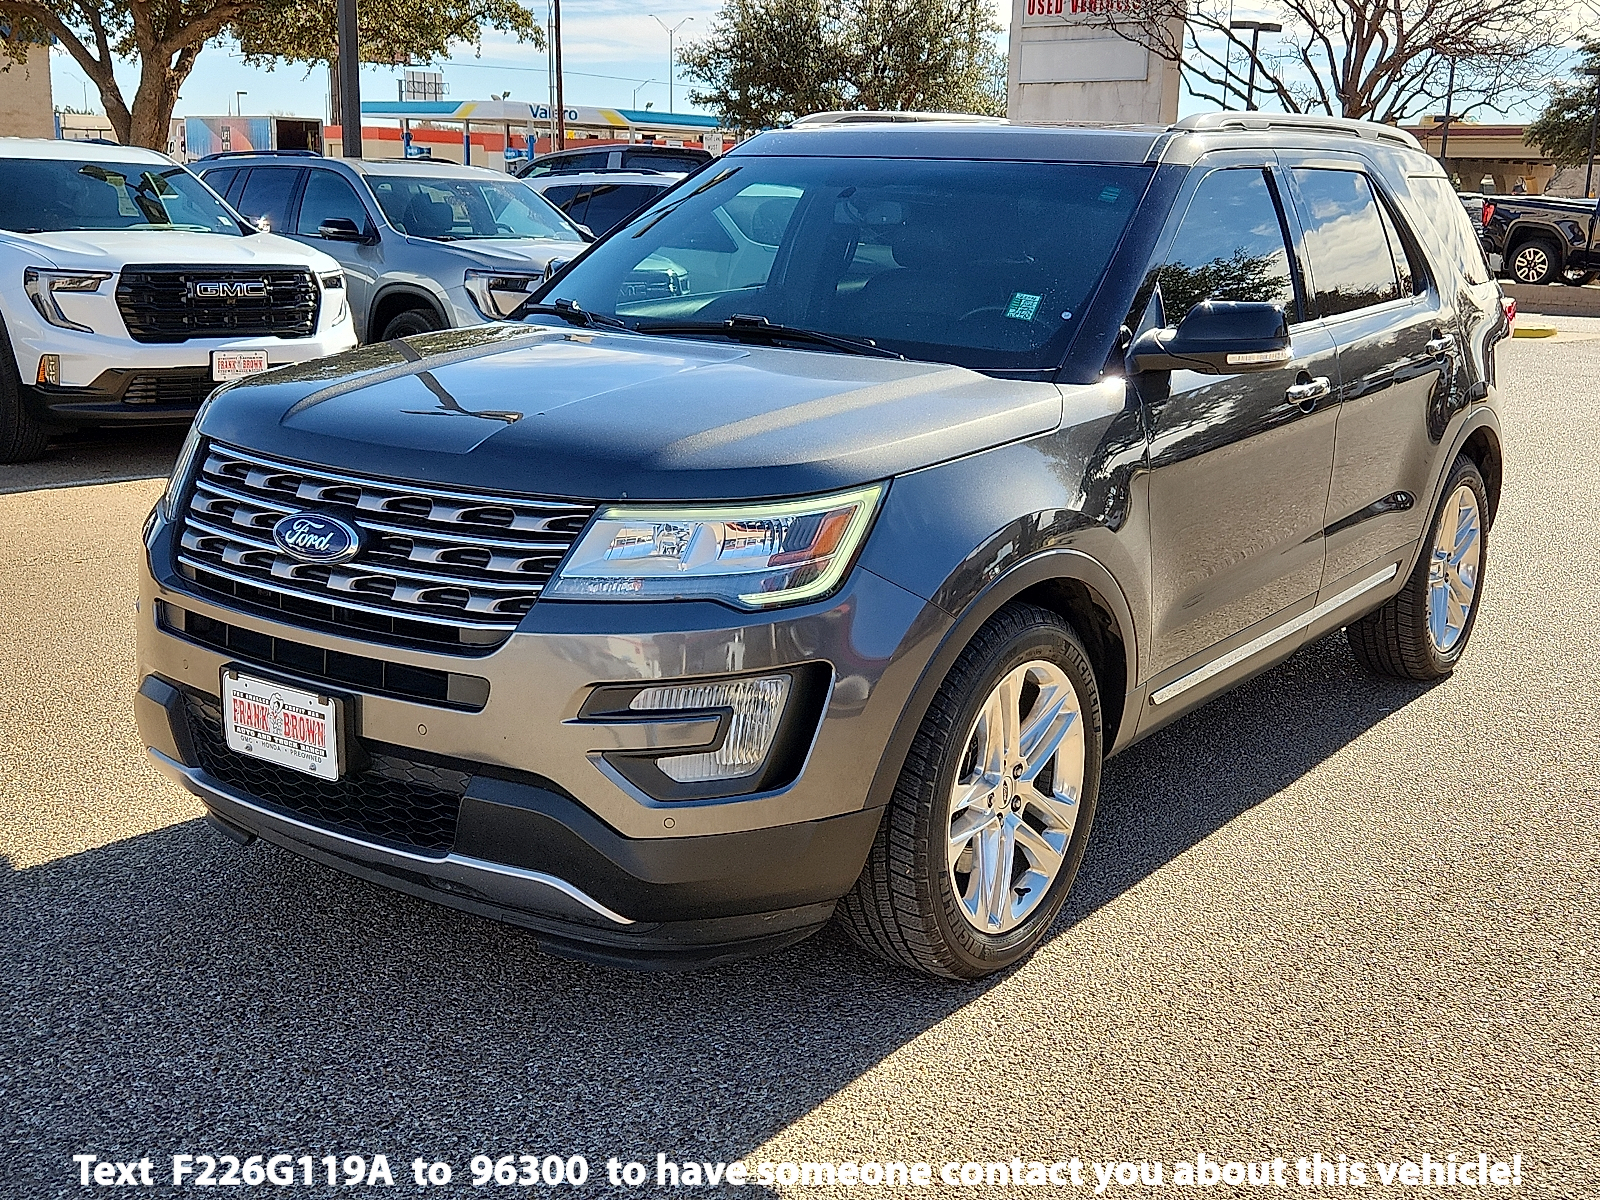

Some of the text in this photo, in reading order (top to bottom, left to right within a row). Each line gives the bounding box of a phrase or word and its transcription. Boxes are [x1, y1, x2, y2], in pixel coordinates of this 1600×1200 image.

[1027, 0, 1063, 15] USED
[529, 104, 578, 121] Valro
[196, 282, 265, 297] GMC
[284, 519, 335, 551] Ford
[232, 697, 326, 748] FRANK BROWN
[236, 726, 325, 757] AUTO AND TRUCK RANCH
[261, 741, 281, 752] HONDA
